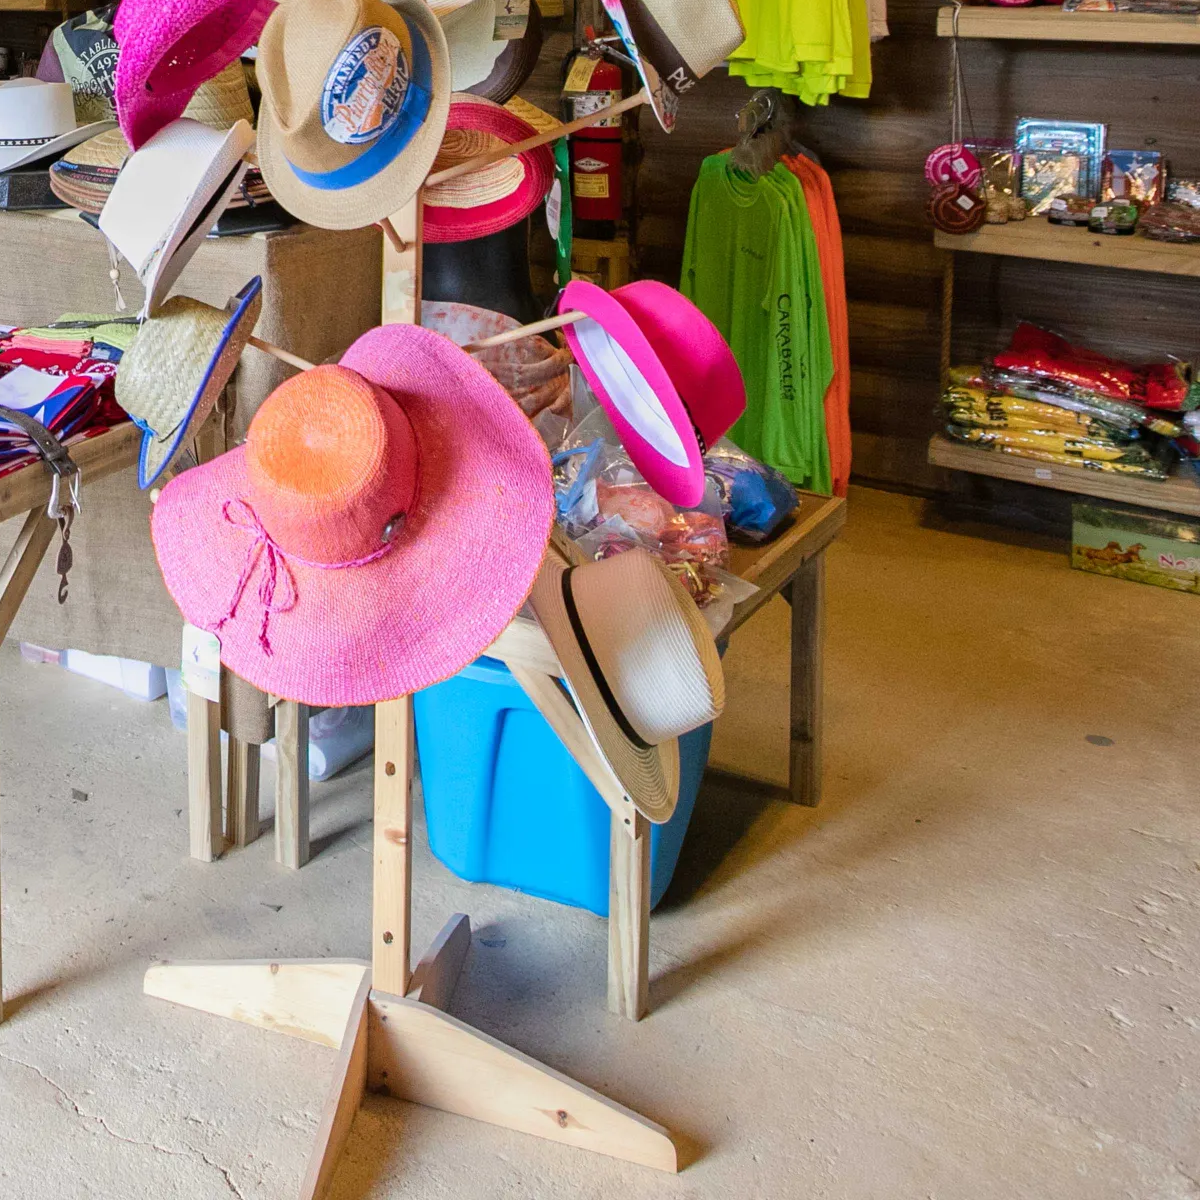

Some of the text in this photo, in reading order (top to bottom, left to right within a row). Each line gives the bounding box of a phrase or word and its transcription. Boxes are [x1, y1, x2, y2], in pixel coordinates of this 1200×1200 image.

[90, 54, 120, 75] 1493
[332, 40, 371, 95] WANTED
[333, 74, 377, 133] Puerto
[776, 293, 796, 392] CARABALÍ
